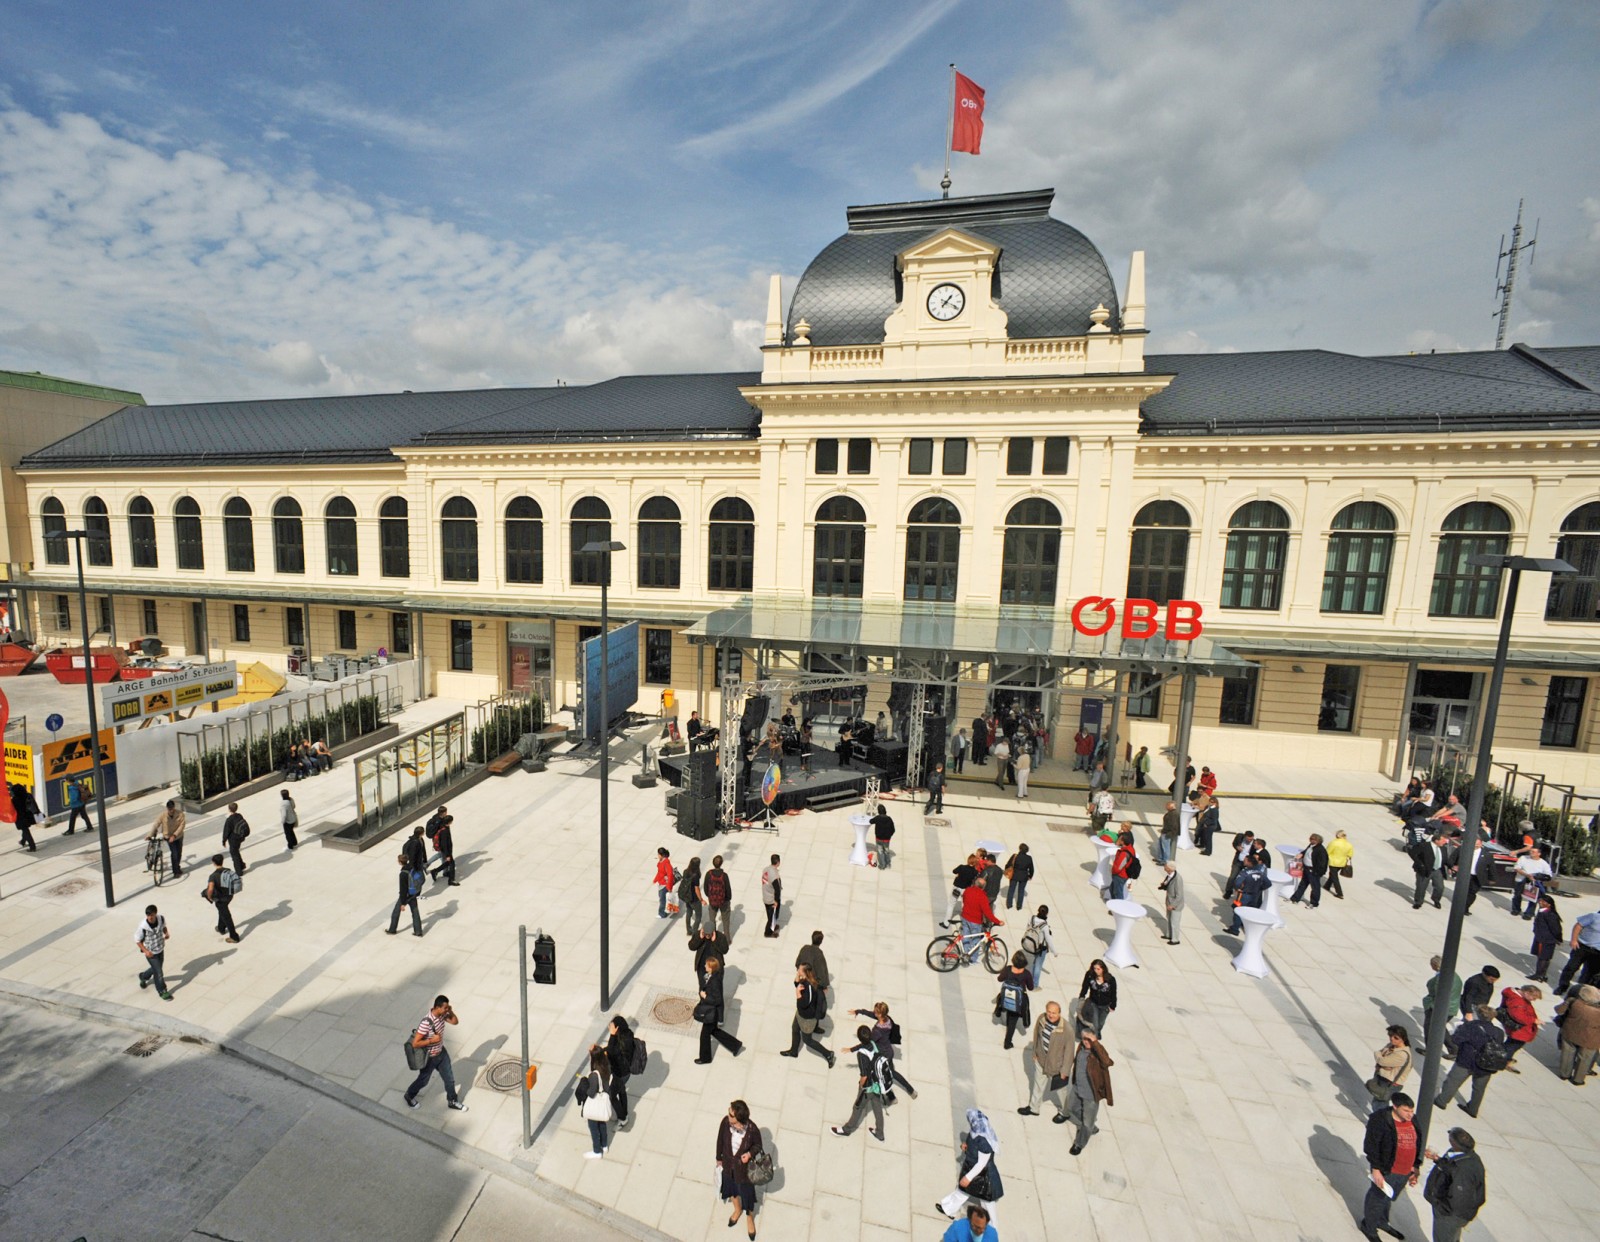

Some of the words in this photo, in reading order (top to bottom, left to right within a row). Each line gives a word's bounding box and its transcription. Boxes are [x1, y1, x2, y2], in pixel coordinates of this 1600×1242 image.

[1071, 595, 1203, 641] ÖBB
[117, 680, 145, 694] ARGE
[150, 672, 189, 687] Bahnhof
[205, 680, 234, 695] HABAU
[4, 747, 28, 760] AIDER
[51, 746, 106, 766] ALPIE
